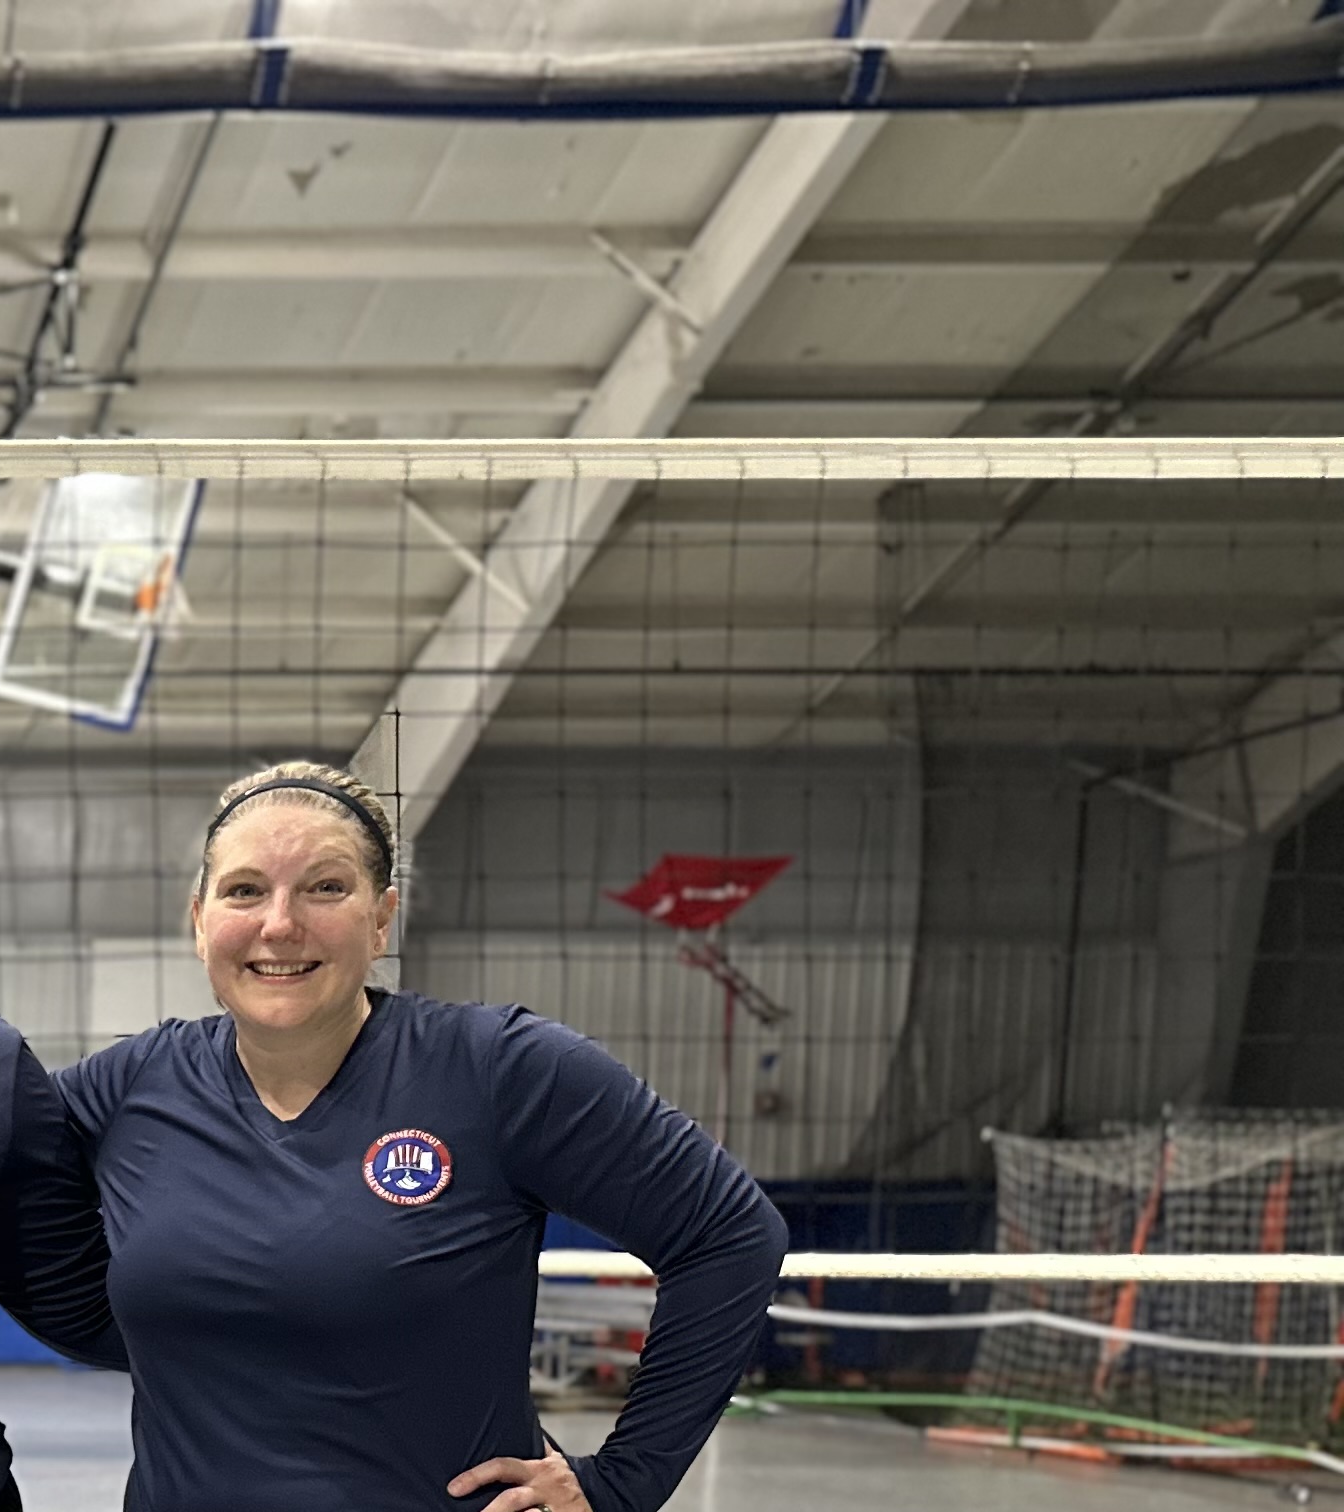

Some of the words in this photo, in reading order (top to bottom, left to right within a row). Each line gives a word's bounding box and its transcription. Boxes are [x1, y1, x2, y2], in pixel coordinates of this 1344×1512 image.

[376, 1129, 442, 1147] CONNECTICUT
[364, 1161, 399, 1203] VOLLEYBALL
[400, 1165, 451, 1204] TOURNAMENTS
